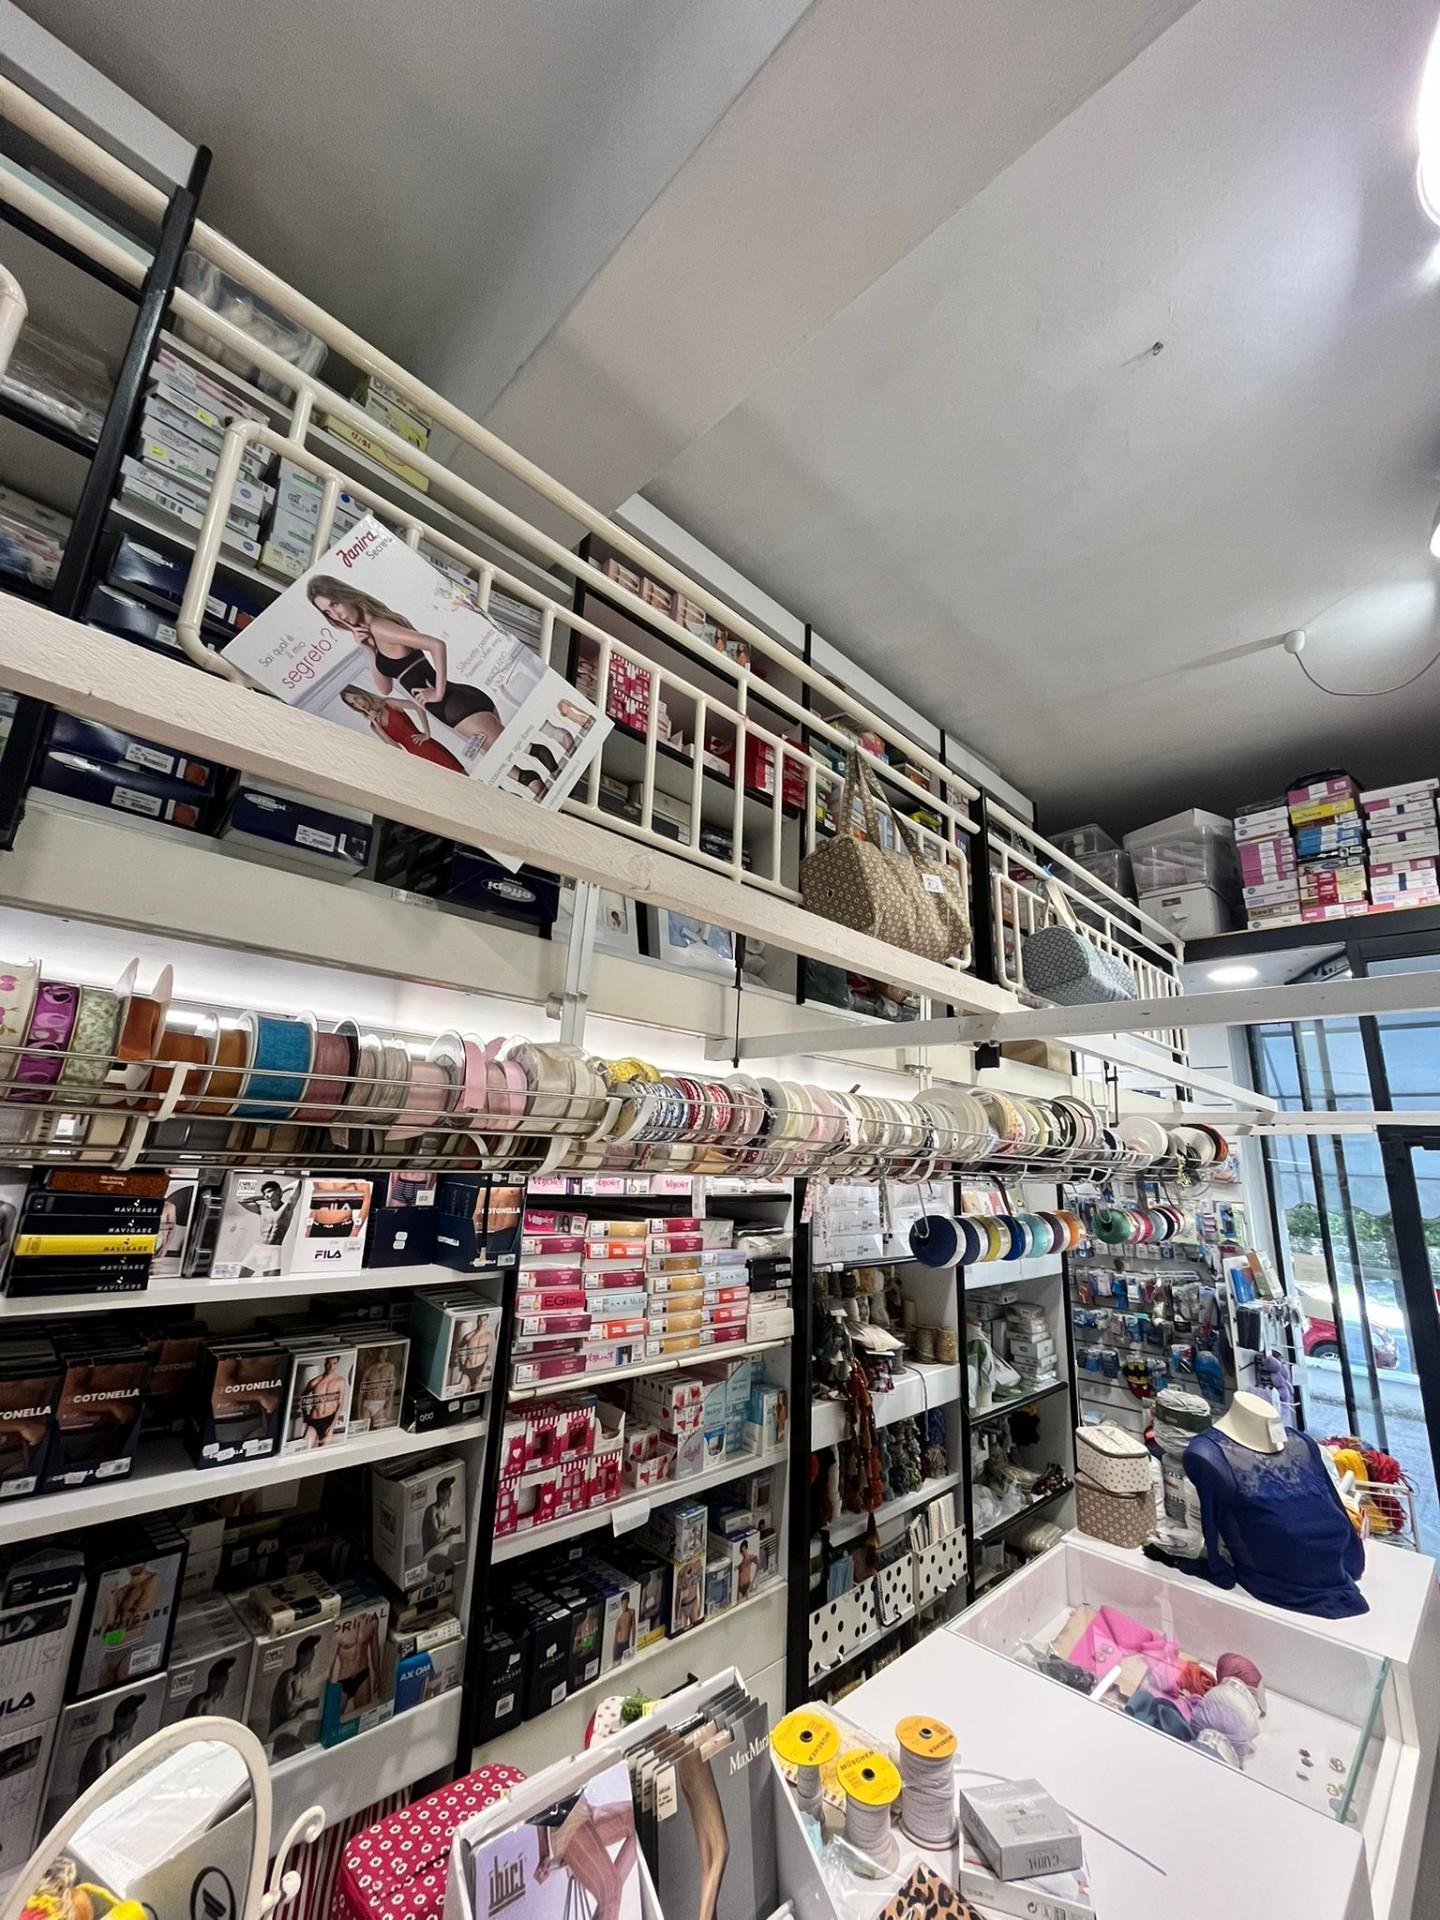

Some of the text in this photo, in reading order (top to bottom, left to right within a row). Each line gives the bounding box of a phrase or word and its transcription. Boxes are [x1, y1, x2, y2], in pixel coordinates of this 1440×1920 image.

[336, 531, 377, 568] Janira
[281, 627, 338, 689] segreto?
[315, 1250, 342, 1259] FILA
[224, 1379, 283, 1394] COTONELLA
[73, 1388, 140, 1403] COTONELLA
